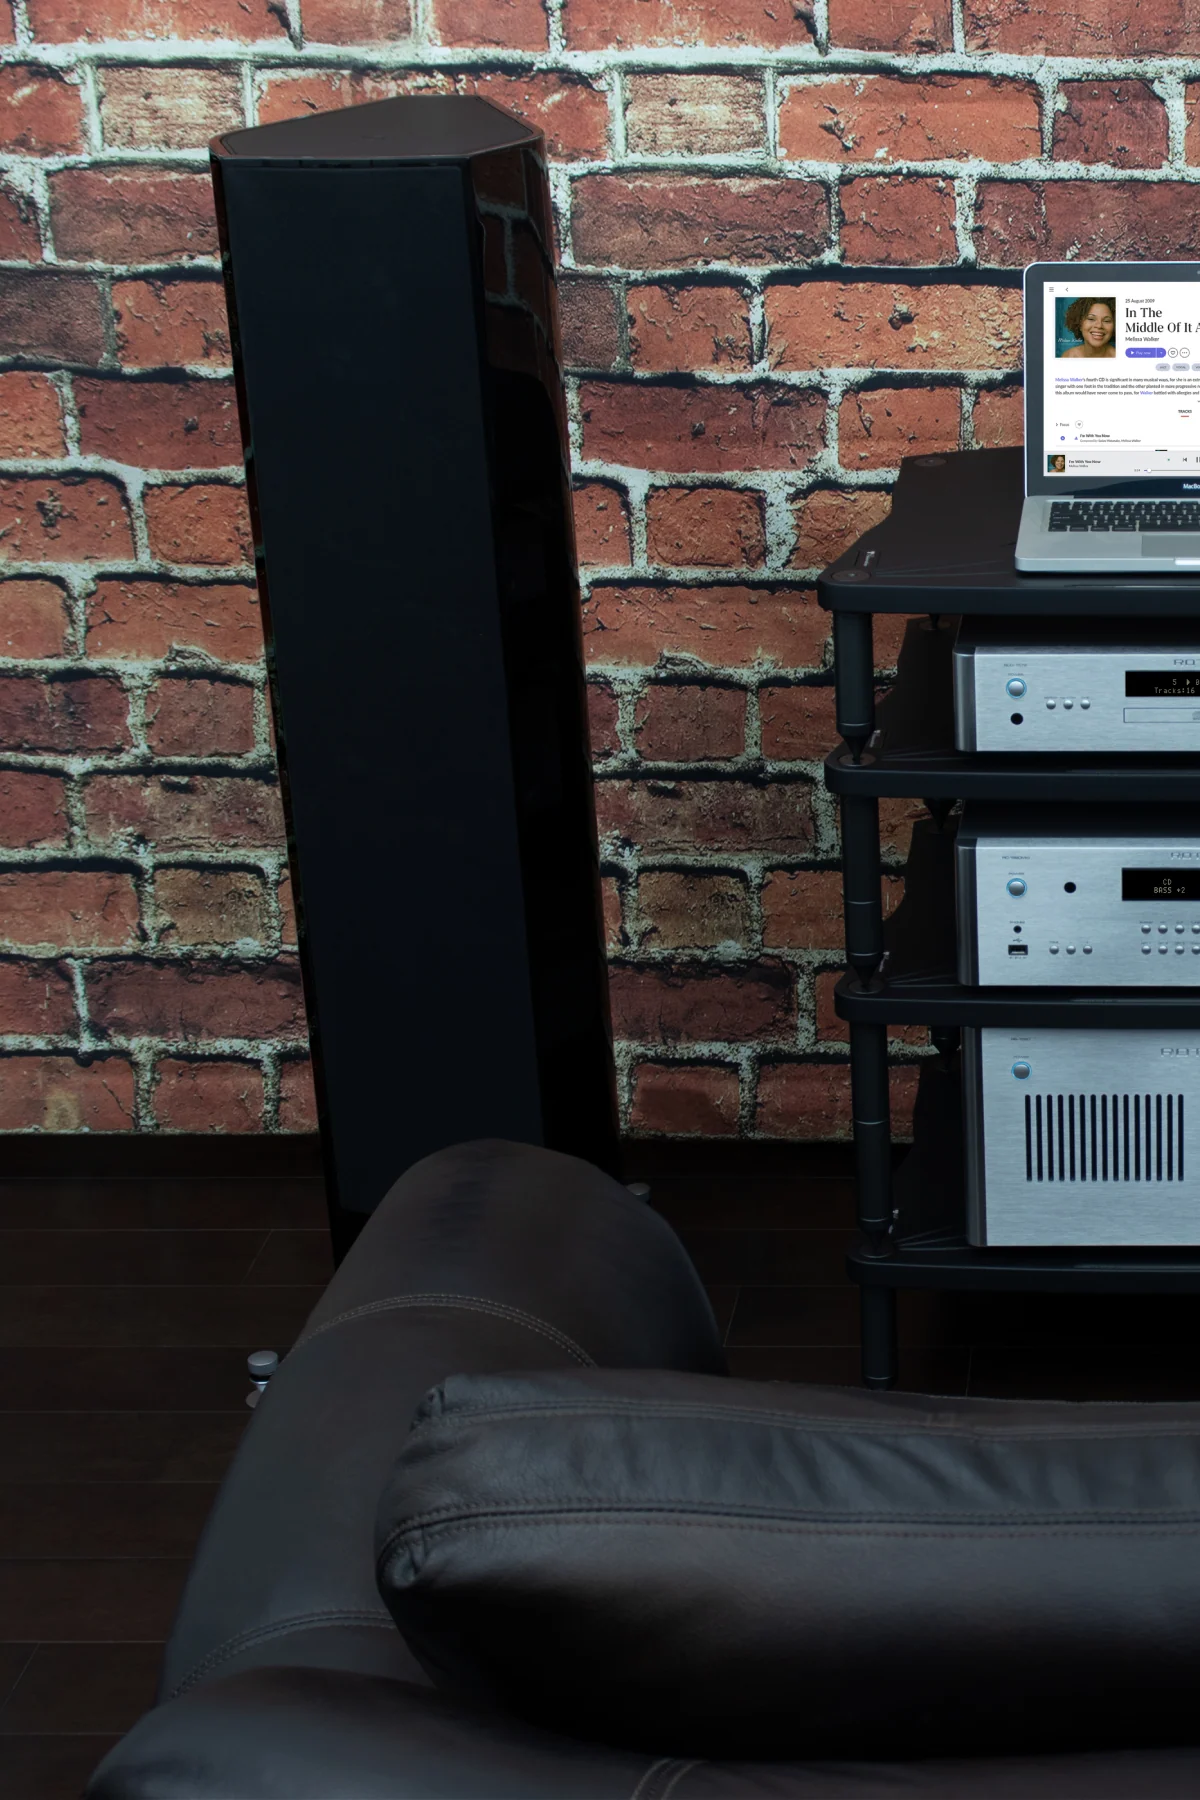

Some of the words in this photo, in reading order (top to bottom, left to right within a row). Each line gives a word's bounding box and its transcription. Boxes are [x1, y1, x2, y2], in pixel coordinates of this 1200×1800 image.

[1125, 307, 1137, 318] In
[1140, 307, 1162, 318] The
[1125, 322, 1164, 333] Middle
[1167, 322, 1181, 333] Of
[1184, 322, 1192, 333] It
